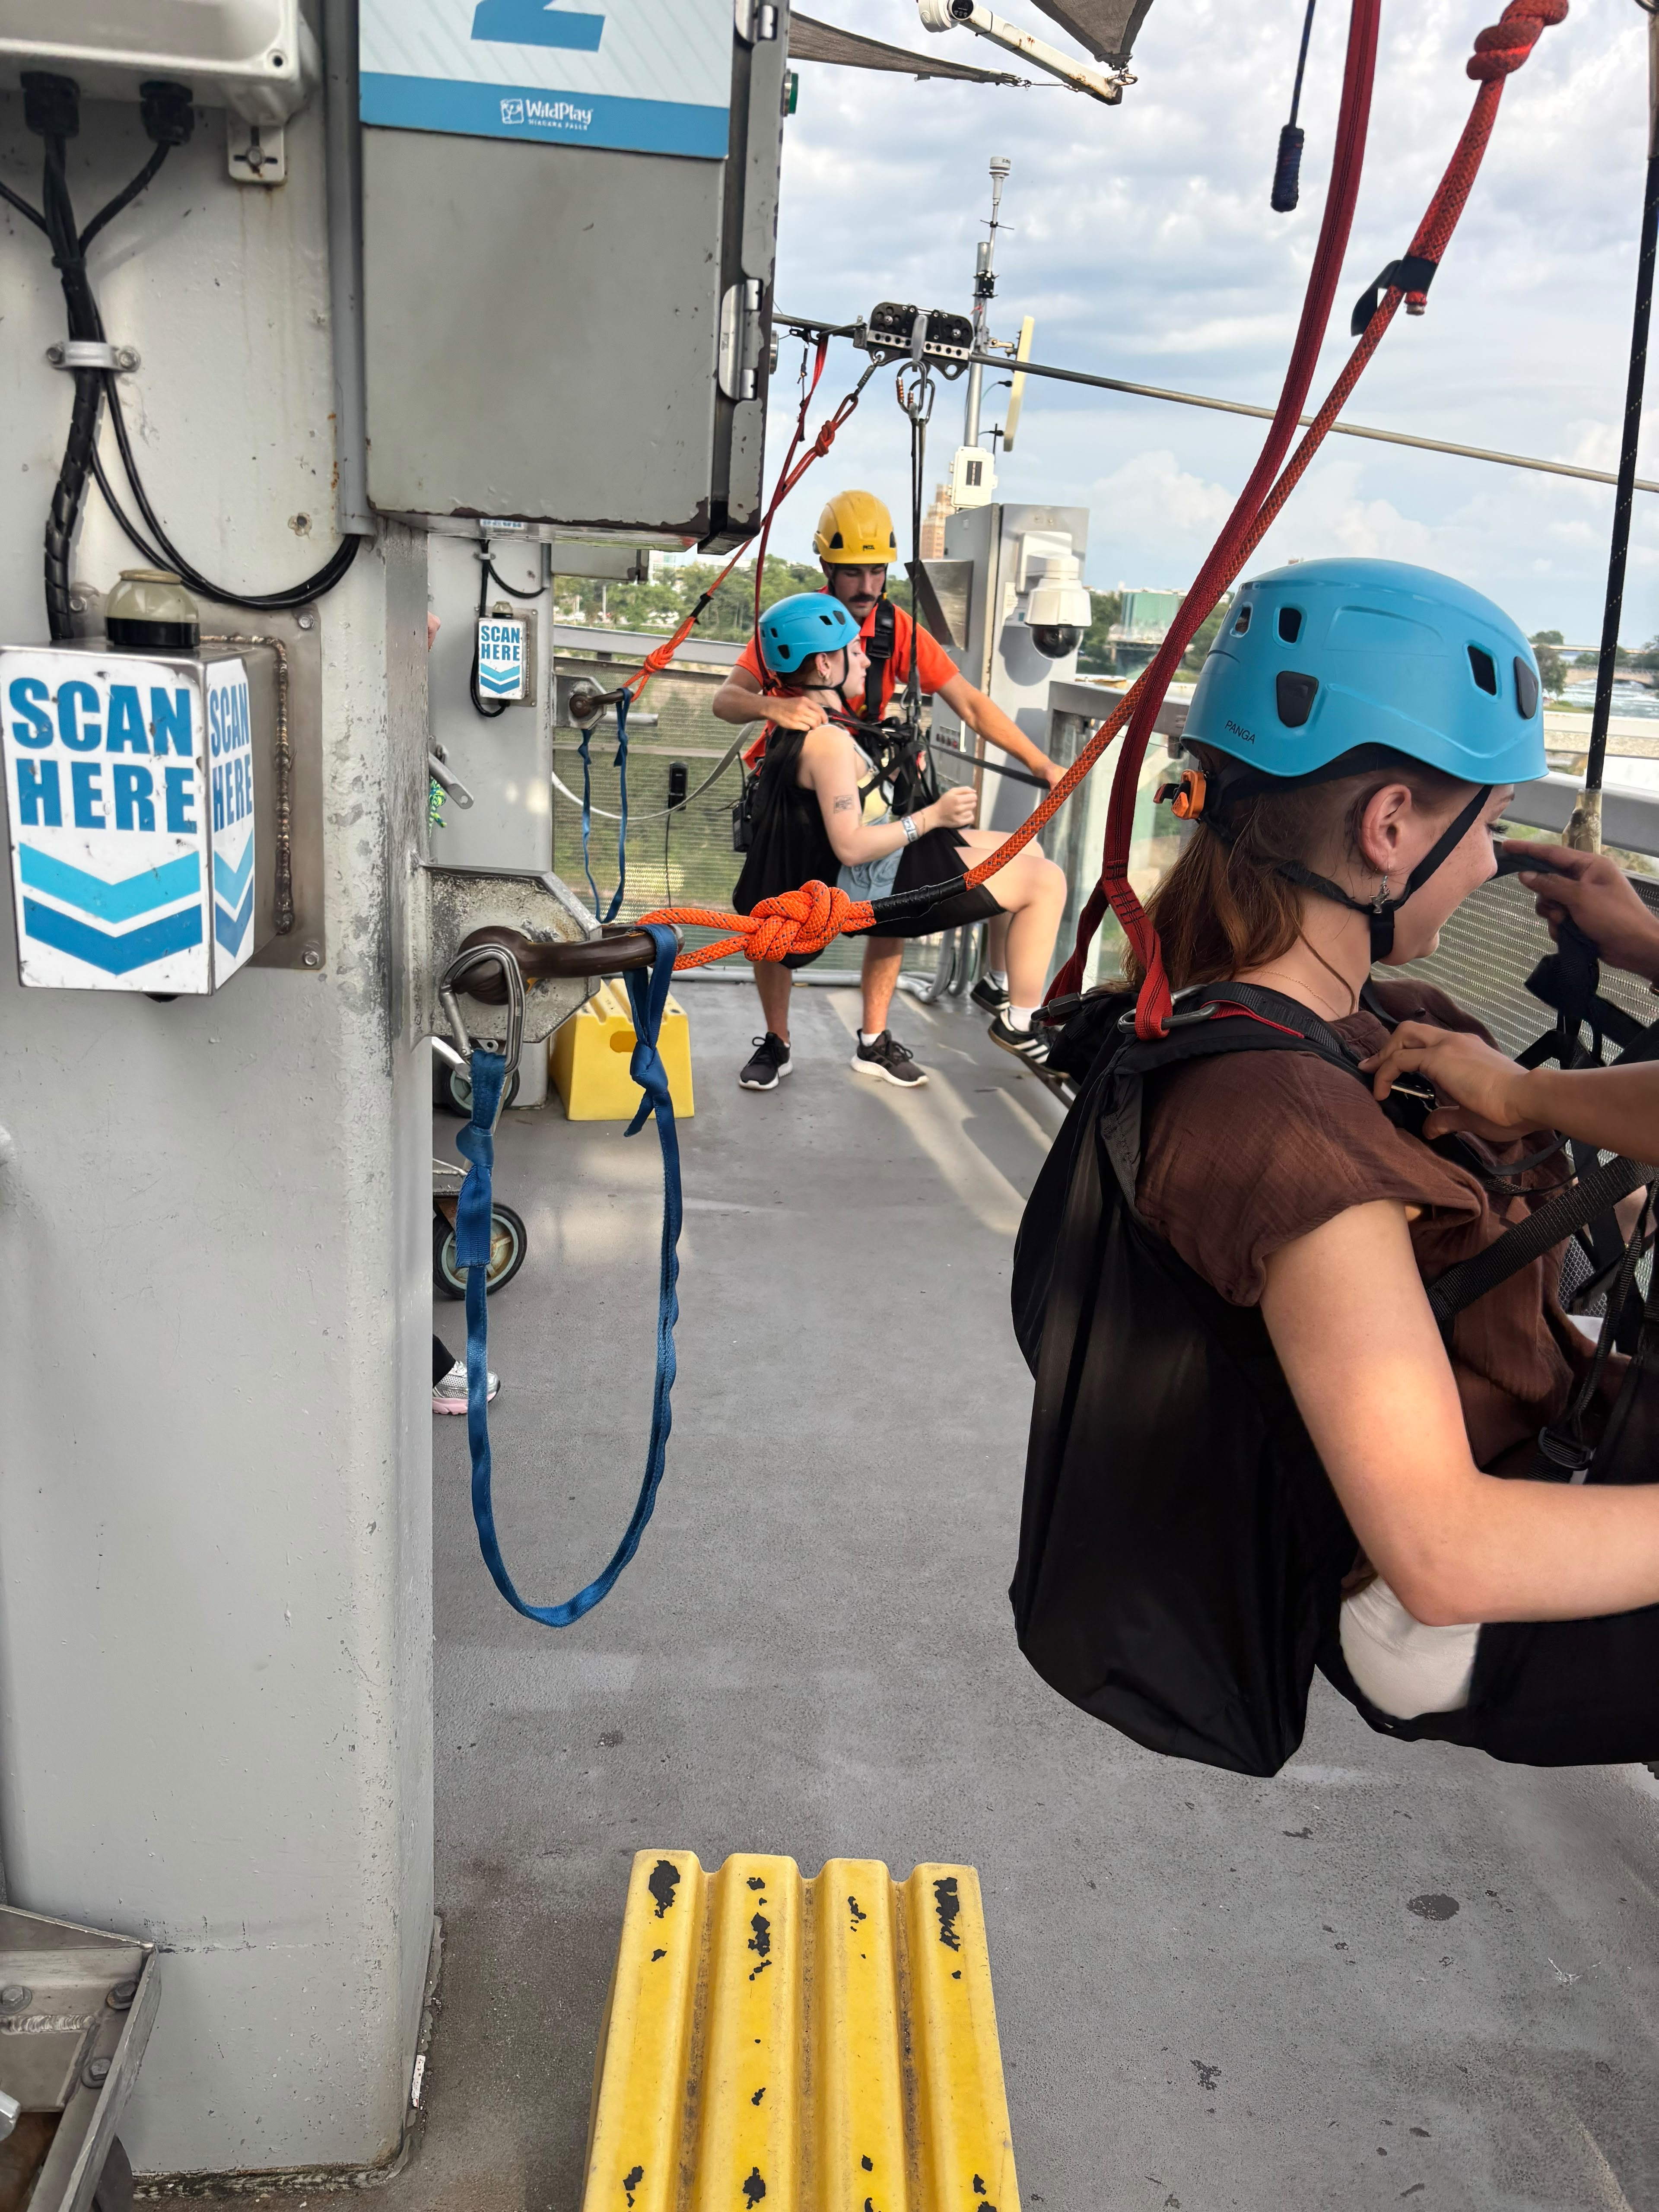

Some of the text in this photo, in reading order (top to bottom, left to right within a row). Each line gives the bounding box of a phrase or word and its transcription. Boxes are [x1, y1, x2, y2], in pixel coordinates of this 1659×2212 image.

[525, 99, 592, 125] WildPlay
[481, 625, 520, 644] SCAN
[481, 643, 520, 661] HERE
[9, 677, 193, 757] SCAN
[210, 682, 249, 758] SCAN
[1224, 720, 1256, 744] PANGA
[16, 758, 198, 834] HERE
[213, 753, 253, 832] HERE
